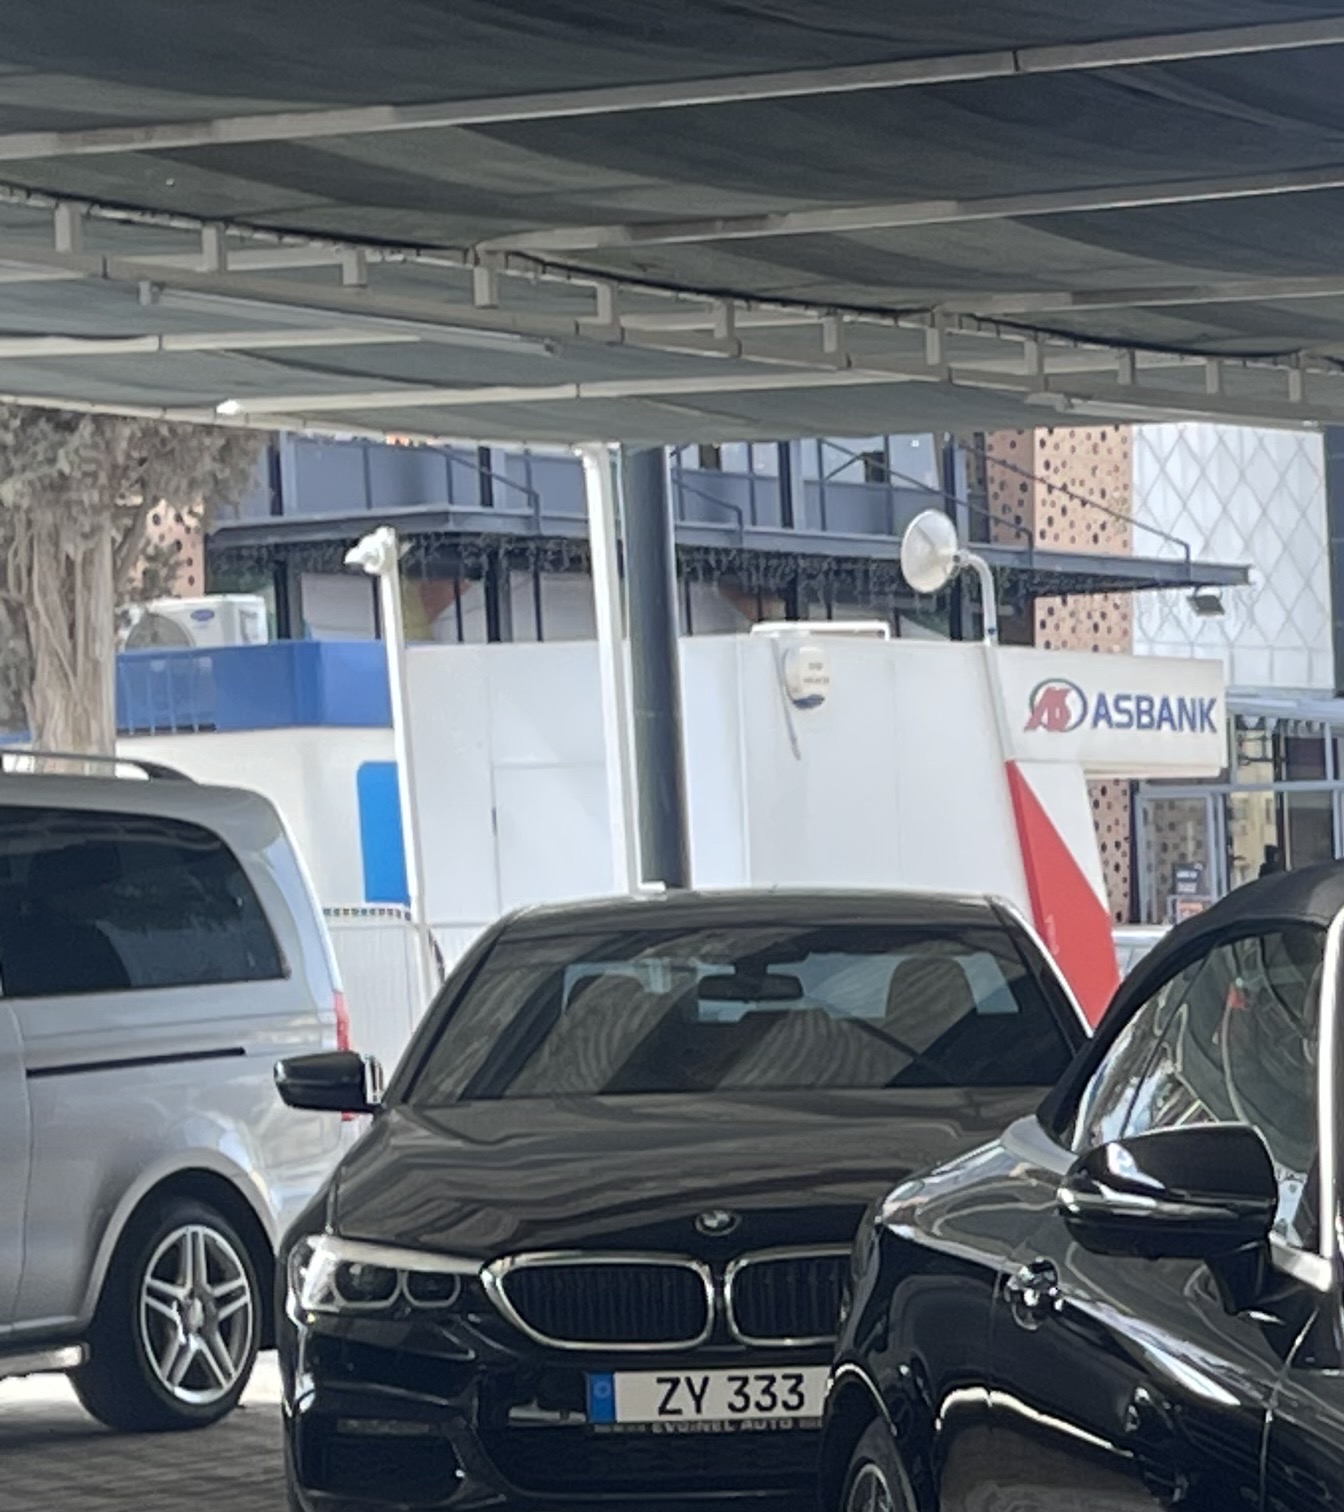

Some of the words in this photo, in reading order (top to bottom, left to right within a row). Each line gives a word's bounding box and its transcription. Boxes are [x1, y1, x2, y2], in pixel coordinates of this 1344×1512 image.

[1091, 692, 1218, 734] ASBANK
[656, 1376, 709, 1416] ZY
[727, 1373, 805, 1414] 333
